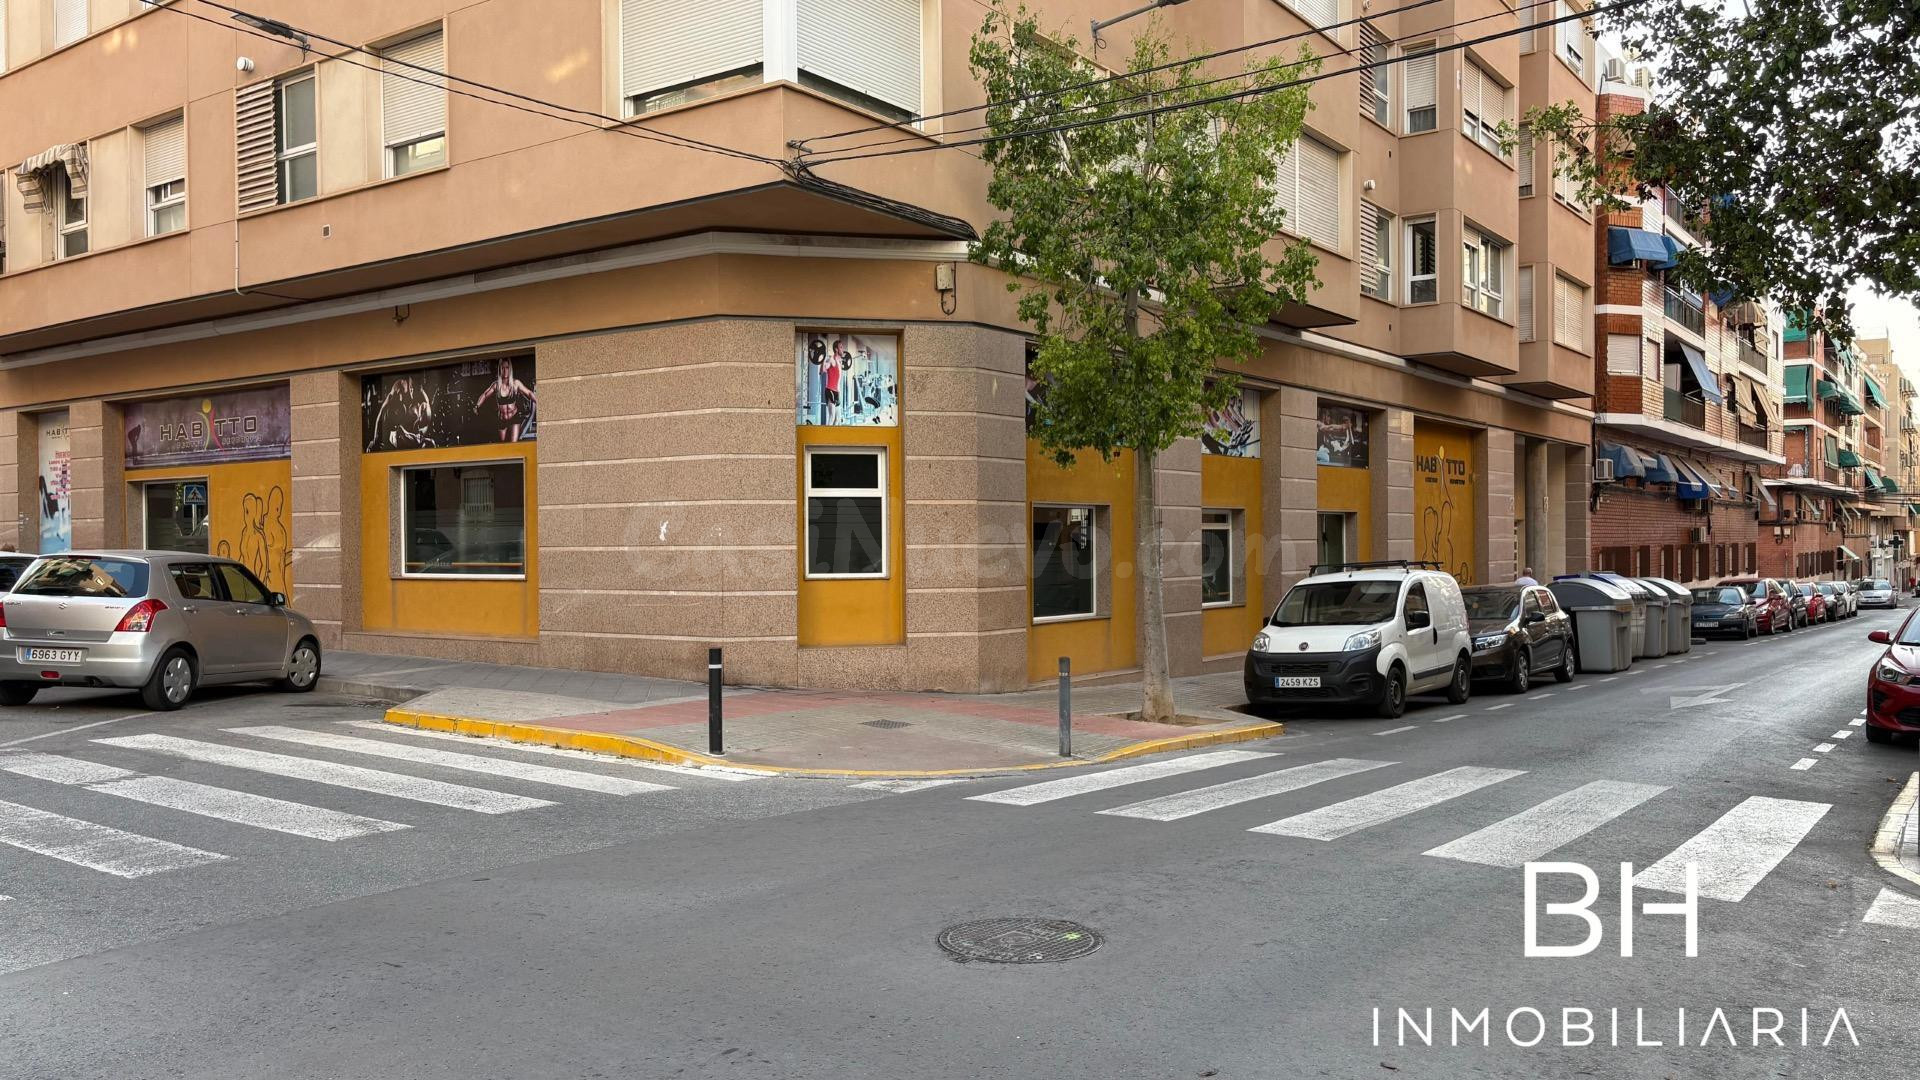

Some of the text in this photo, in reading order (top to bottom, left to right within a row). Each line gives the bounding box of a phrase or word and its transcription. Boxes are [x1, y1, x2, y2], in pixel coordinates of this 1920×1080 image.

[32, 649, 80, 661] 6963 GYY
[1281, 678, 1319, 687] 2459 KZS
